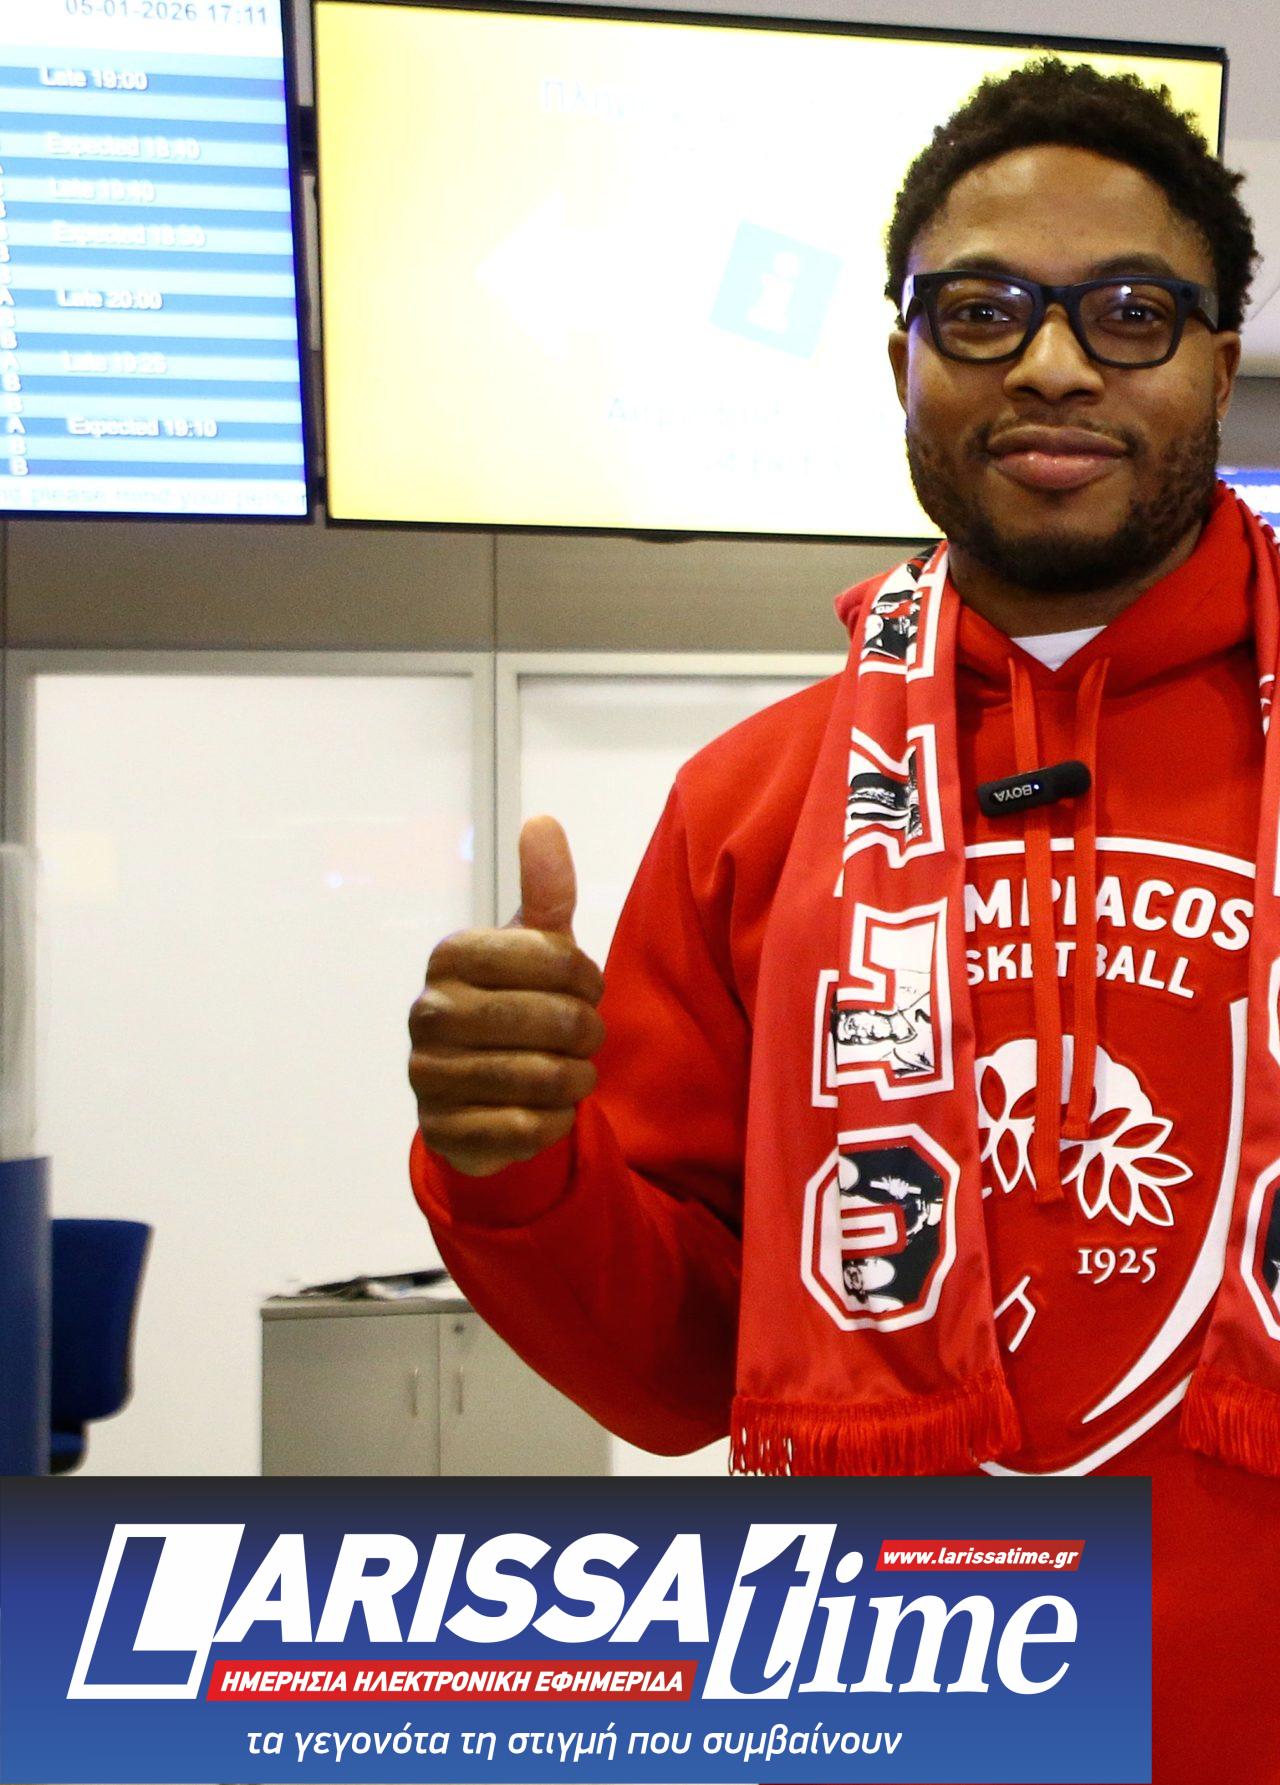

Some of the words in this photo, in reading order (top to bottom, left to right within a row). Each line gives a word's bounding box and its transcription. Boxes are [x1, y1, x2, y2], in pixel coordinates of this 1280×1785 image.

[65, 0, 198, 21] 05-01-2026
[208, 4, 268, 25] 17:11
[994, 784, 1033, 803] BOYA
[1078, 1247, 1158, 1284] 1925
